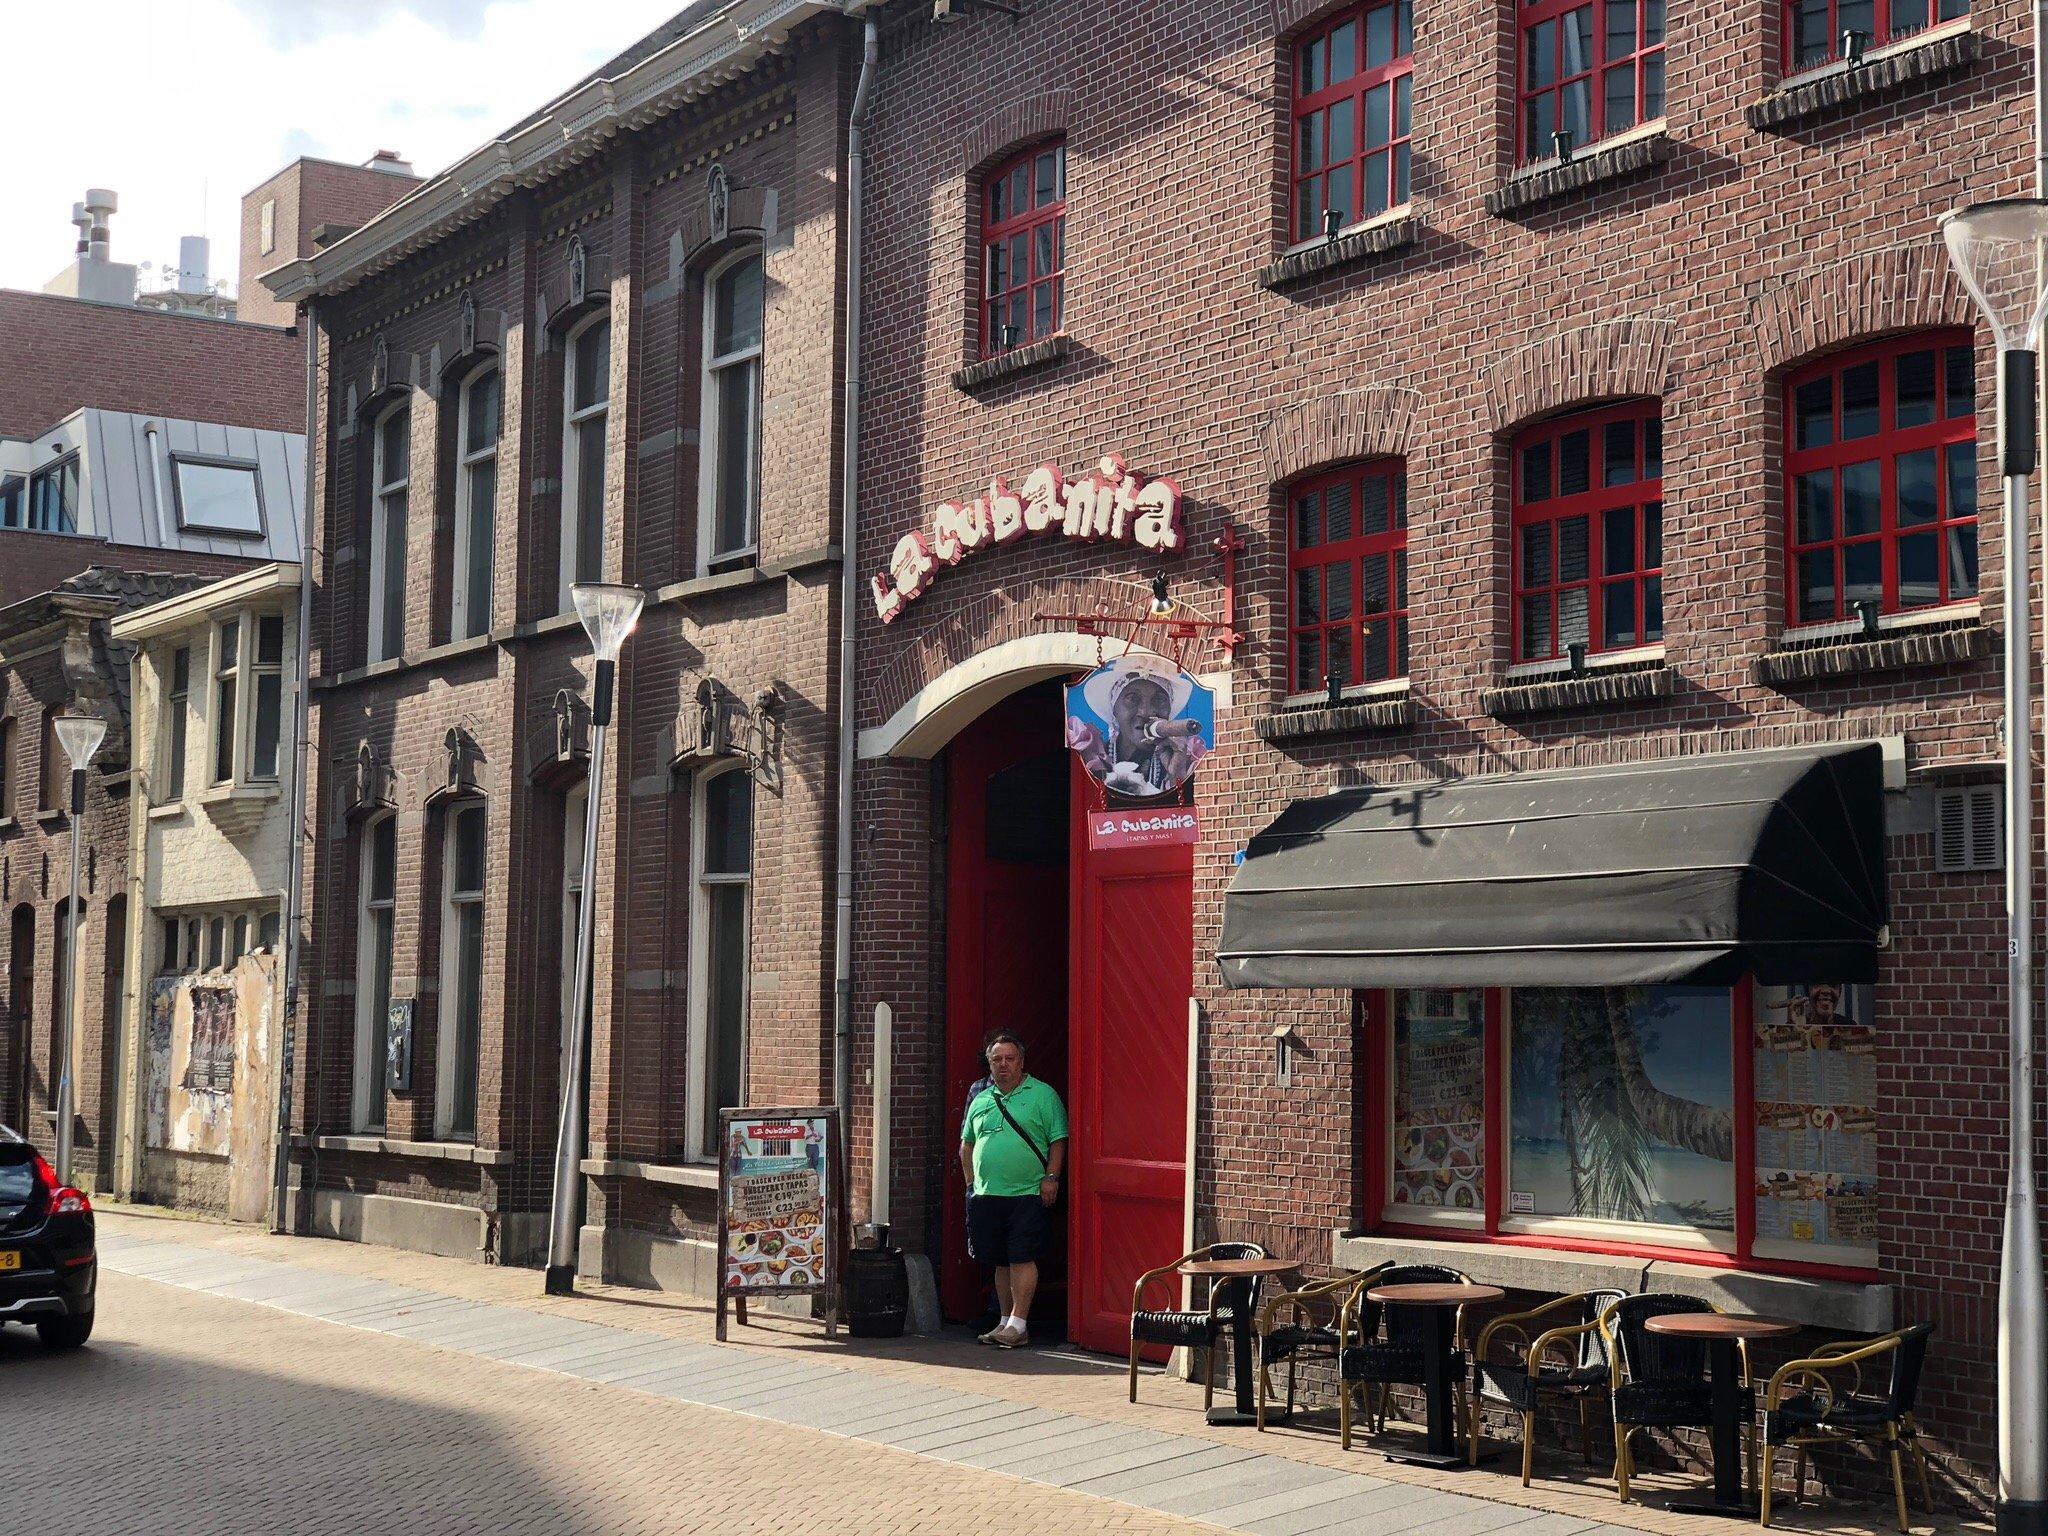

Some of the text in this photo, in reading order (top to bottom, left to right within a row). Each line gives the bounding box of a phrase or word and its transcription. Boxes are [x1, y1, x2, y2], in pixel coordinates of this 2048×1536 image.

[871, 530, 936, 624] La
[1096, 813, 1197, 836] La Cubanita
[2009, 941, 2017, 955] 3
[785, 1180, 808, 1190] TAPAS
